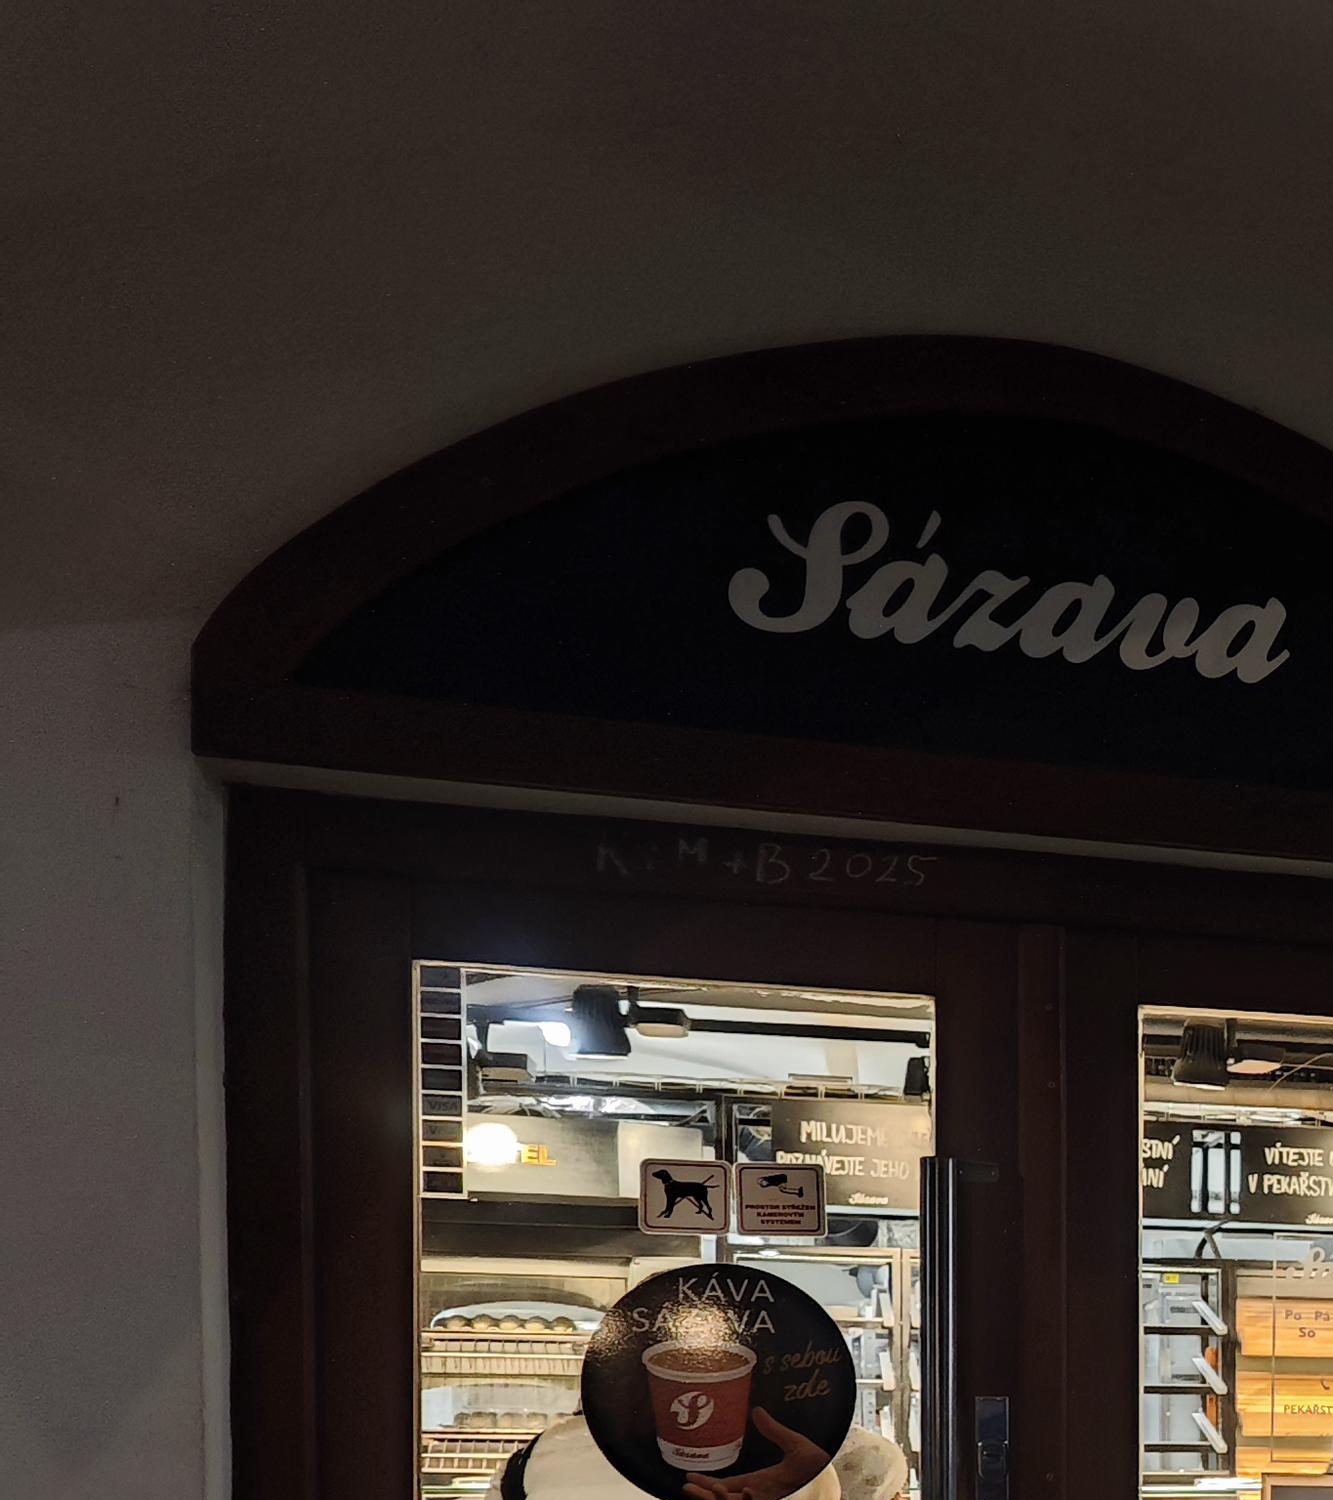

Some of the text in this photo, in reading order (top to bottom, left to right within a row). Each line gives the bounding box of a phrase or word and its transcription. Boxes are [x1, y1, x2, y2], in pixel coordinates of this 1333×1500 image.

[728, 501, 1290, 683] Sázava
[809, 846, 939, 886] 2025
[1264, 1142, 1324, 1167] VÍTEJTE
[1247, 1173, 1259, 1195] V
[677, 1272, 775, 1303] KÁVA
[1284, 1309, 1302, 1321] Po
[1298, 1326, 1317, 1339] So
[779, 1340, 842, 1373] sebou
[783, 1368, 831, 1402] zde
